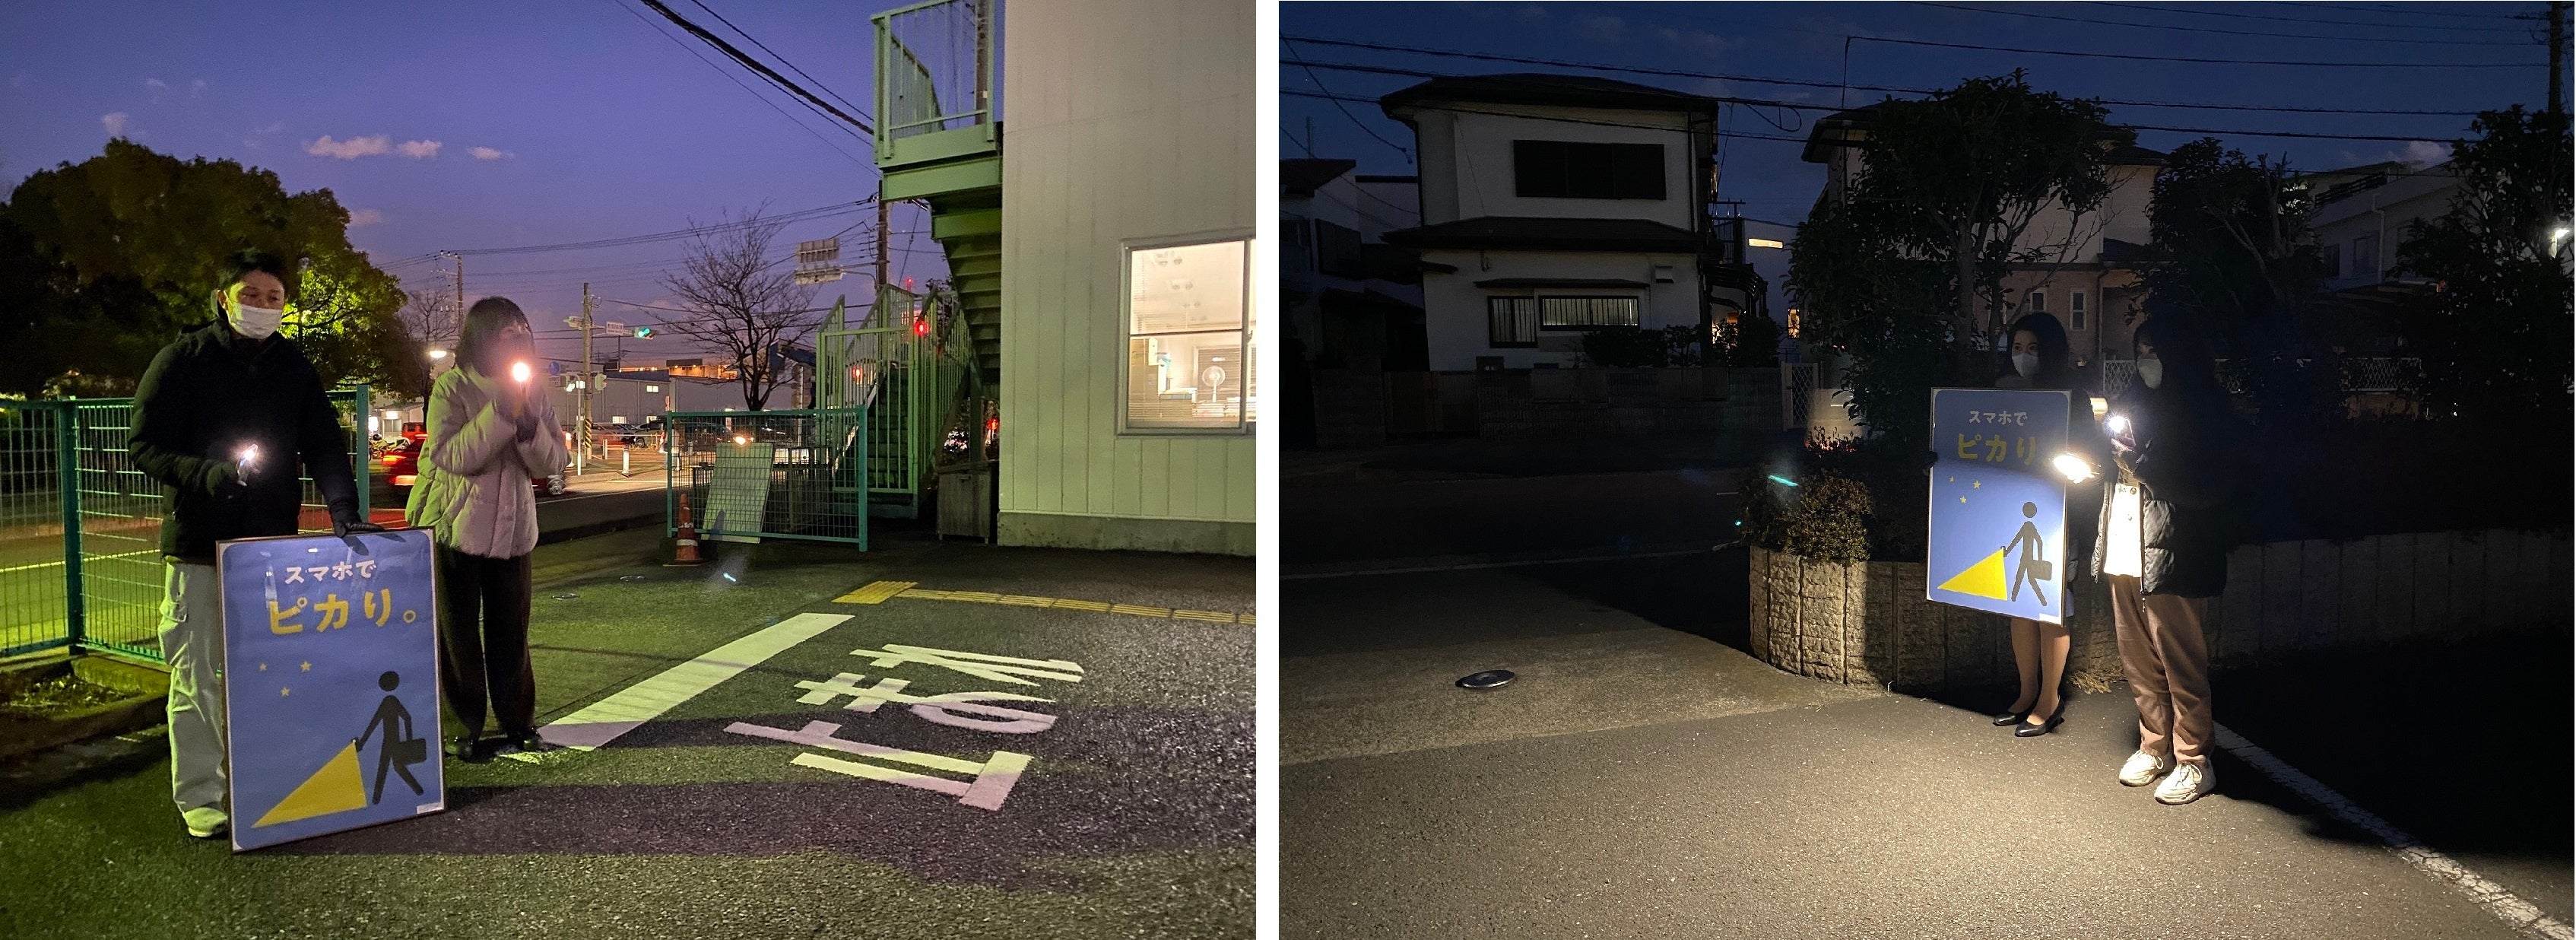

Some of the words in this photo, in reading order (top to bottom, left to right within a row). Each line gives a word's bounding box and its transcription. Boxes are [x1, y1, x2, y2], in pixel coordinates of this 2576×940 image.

[1969, 411, 2028, 426] スマホで
[286, 560, 376, 584] スマホで
[269, 589, 417, 634] ピカり。
[724, 643, 1085, 811] 止まれ
